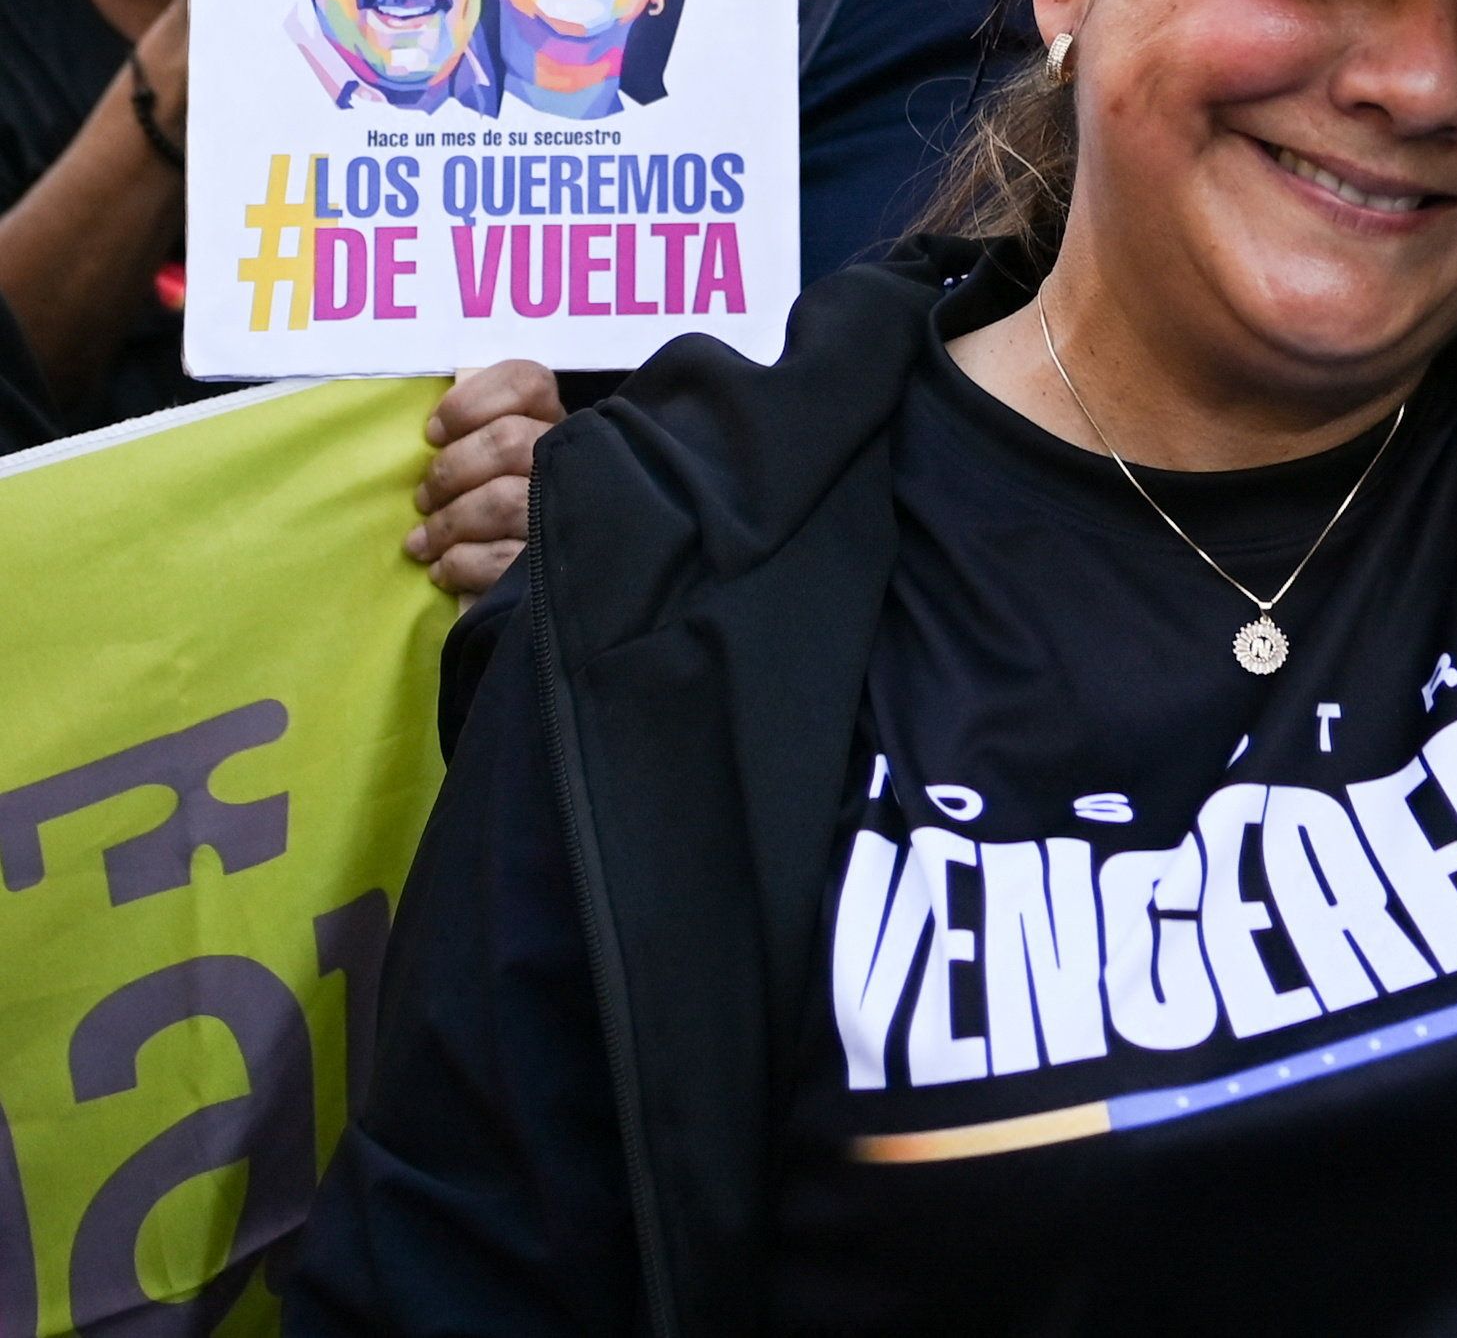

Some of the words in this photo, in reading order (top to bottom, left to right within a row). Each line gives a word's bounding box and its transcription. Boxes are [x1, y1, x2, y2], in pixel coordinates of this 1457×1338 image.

[368, 130, 409, 147] Hace
[415, 132, 435, 146] un
[441, 132, 476, 146] mes
[483, 129, 501, 146] de
[508, 131, 527, 146] su
[534, 129, 621, 146] secuestro
[443, 152, 745, 226] QUEREMOS
[312, 224, 417, 320] DE
[452, 222, 746, 318] VUELTA
